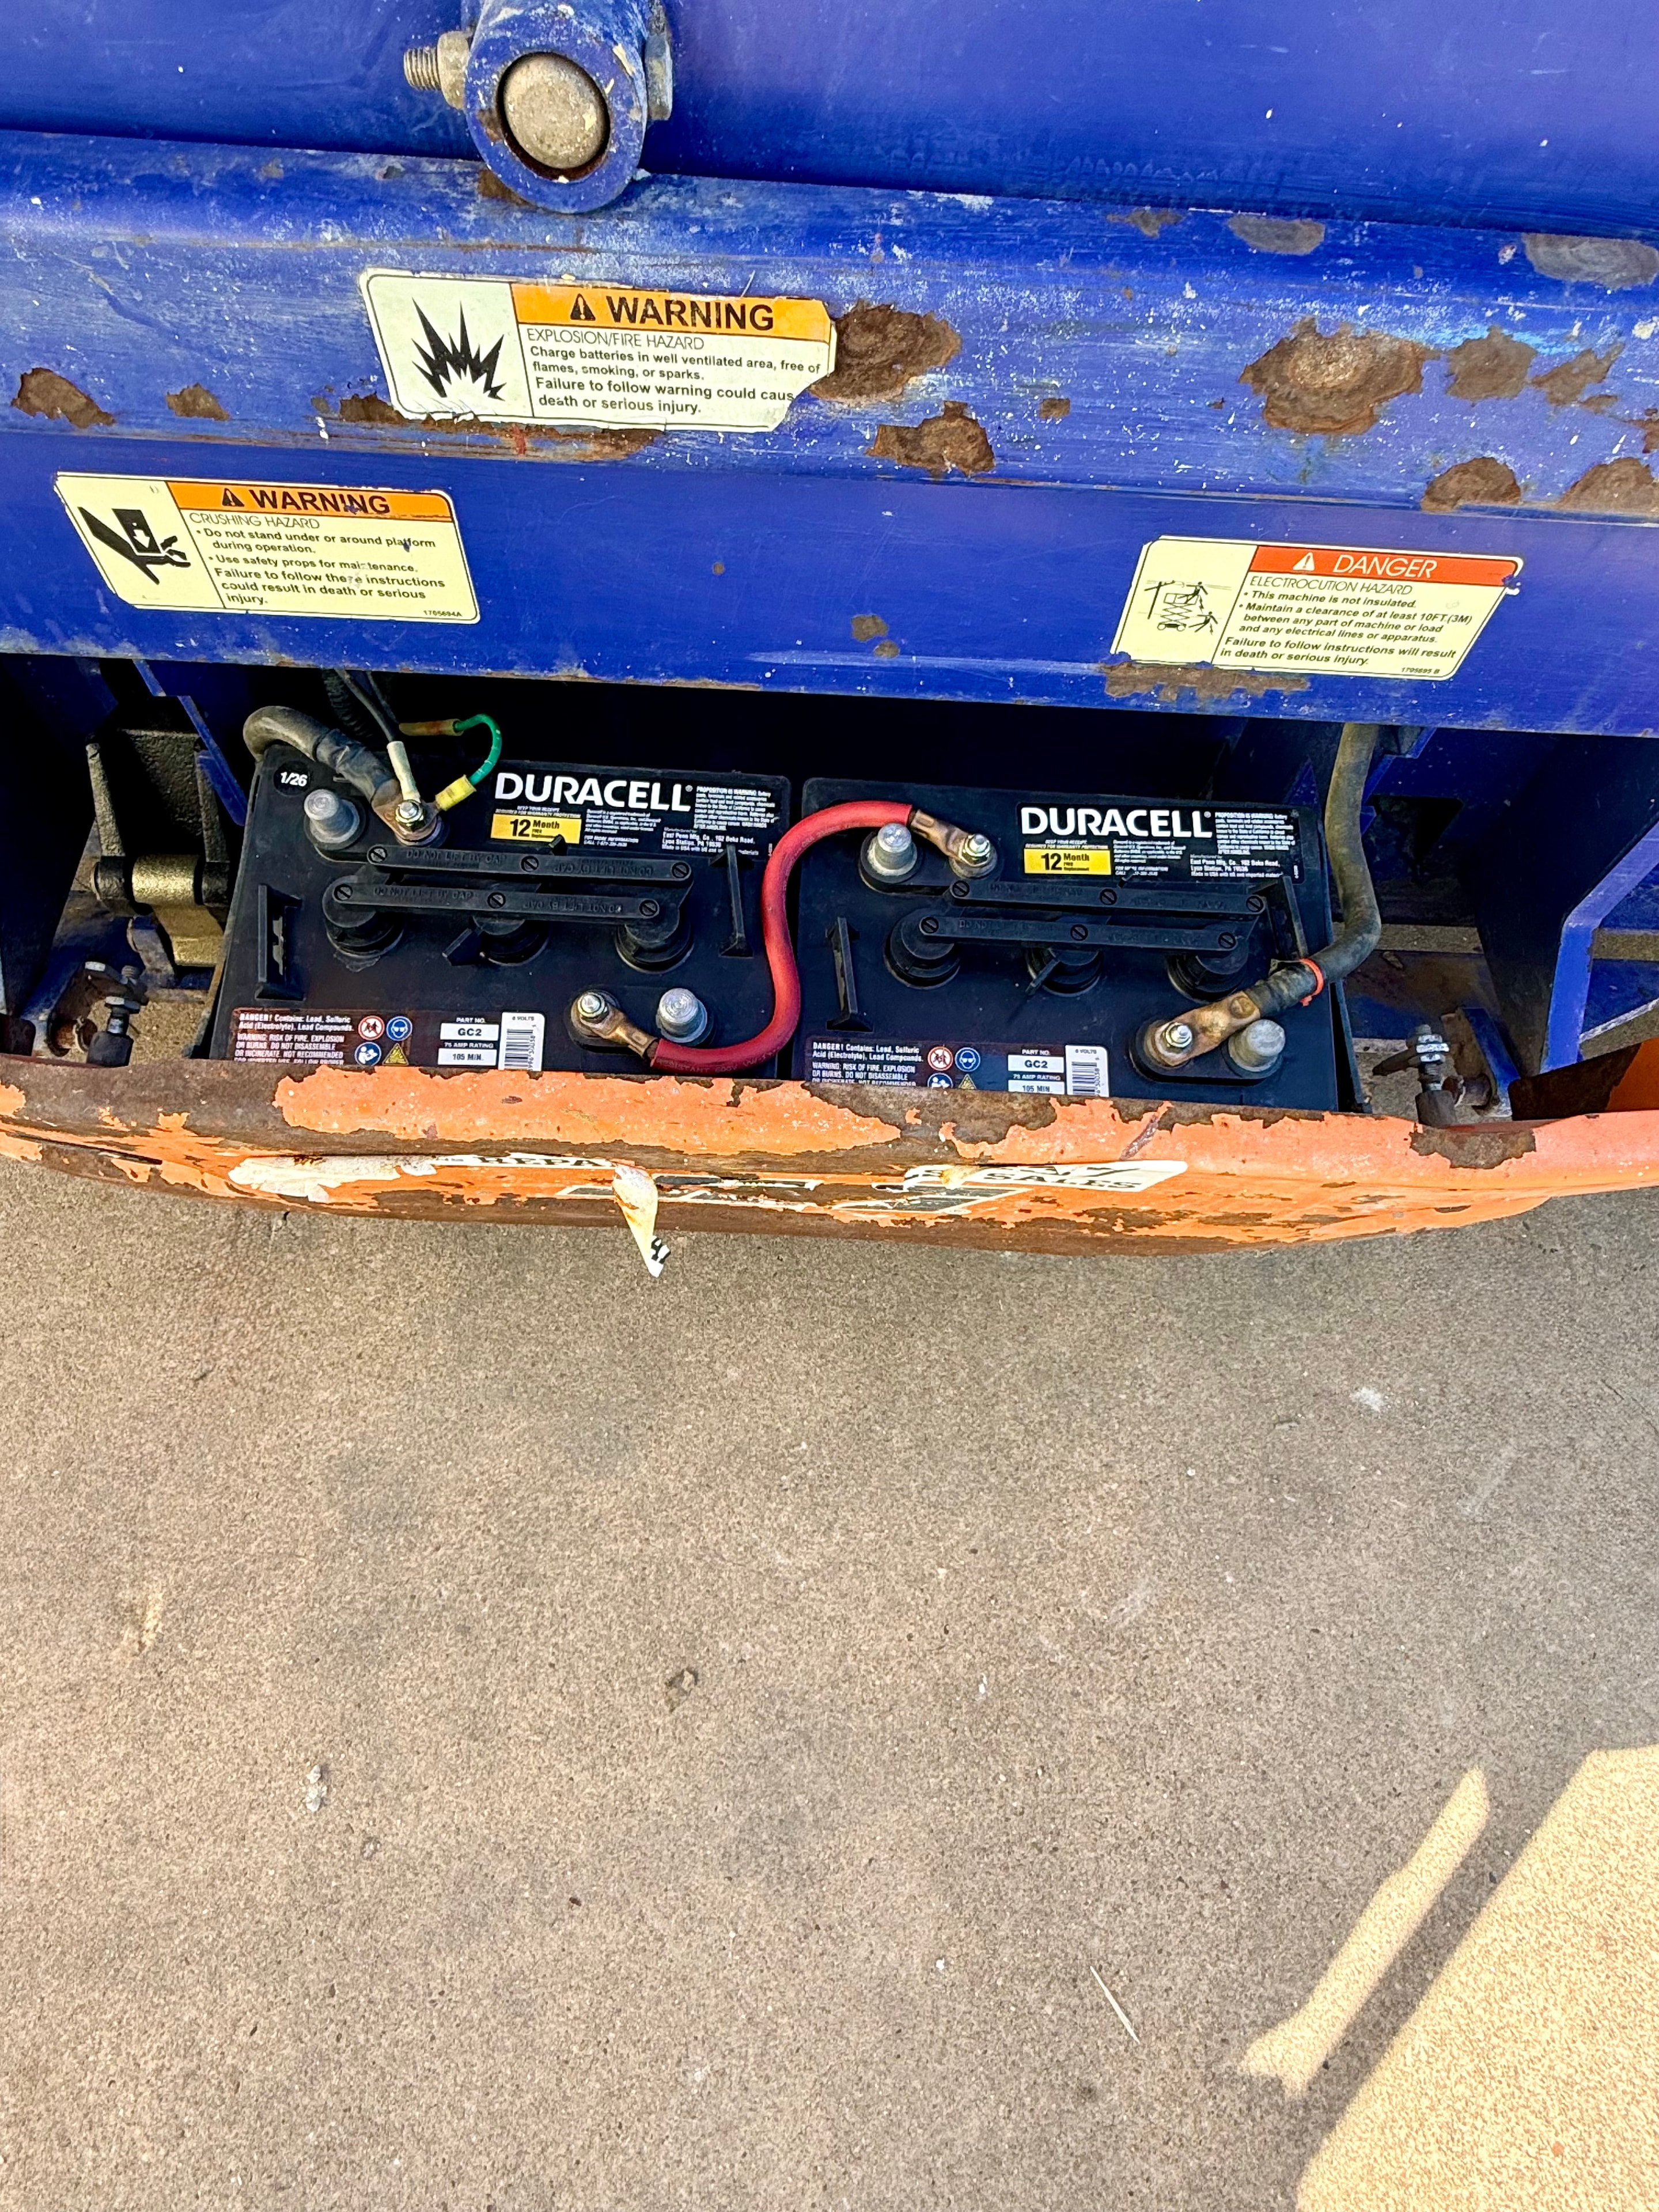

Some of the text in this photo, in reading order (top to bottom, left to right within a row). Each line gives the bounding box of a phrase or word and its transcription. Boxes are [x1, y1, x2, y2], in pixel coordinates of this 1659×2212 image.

[606, 296, 773, 331] WARNING
[527, 328, 704, 350] EXPLOSION/FIRE HAZARD
[531, 346, 821, 374] Charge batteries in well ventilated area, free of
[533, 361, 704, 380] flames, smoking, or sparks.
[536, 376, 794, 400] Failure to follow warning could caus
[539, 395, 701, 415] death or serious injury.
[249, 489, 390, 514] WARNING
[189, 512, 320, 529] CRUSHING HAZARD
[204, 528, 221, 537] Do
[225, 530, 246, 539] not
[248, 530, 282, 540] stand
[285, 533, 320, 541] under
[340, 536, 382, 545] around
[213, 540, 316, 554] during operation.
[215, 554, 240, 563] Use
[243, 556, 278, 567] safety
[282, 559, 316, 569] props
[319, 559, 335, 568] for
[1332, 554, 1437, 578] DANGER
[214, 567, 262, 578] Failure
[265, 570, 279, 579] to
[281, 571, 322, 582] follow
[366, 574, 445, 588] instructions
[1250, 575, 1412, 594] ELECTROCUTION HAZARD
[222, 582, 426, 599] could result in death or serious
[226, 593, 268, 605] injury.
[1252, 590, 1416, 608] This machine is not insulated.
[1245, 603, 1293, 613] Maintain
[1305, 606, 1359, 616] clearance
[1362, 609, 1376, 618] of
[1389, 611, 1417, 620] least
[1244, 613, 1290, 623] between
[1293, 618, 1313, 626] any
[1354, 621, 1402, 630] machine
[1418, 624, 1444, 632] load
[1262, 627, 1283, 635] any
[1286, 627, 1336, 637] electrical
[1338, 630, 1363, 638] lines
[1381, 633, 1438, 643] apparatus.
[1220, 648, 1232, 656] in
[1235, 649, 1268, 658] death
[1286, 653, 1331, 662] serious
[1333, 655, 1369, 665] injury.
[1225, 637, 1456, 658] Failure to follow instructions will result
[281, 771, 308, 787] 1/26
[495, 772, 691, 812] DURACELL
[510, 819, 531, 837] 12
[533, 820, 560, 829] Month
[1021, 807, 1213, 838] DURACELL
[1041, 853, 1062, 870] 12
[1063, 853, 1089, 861] Month
[457, 1028, 482, 1036] GC2
[1024, 1060, 1048, 1068] GC2
